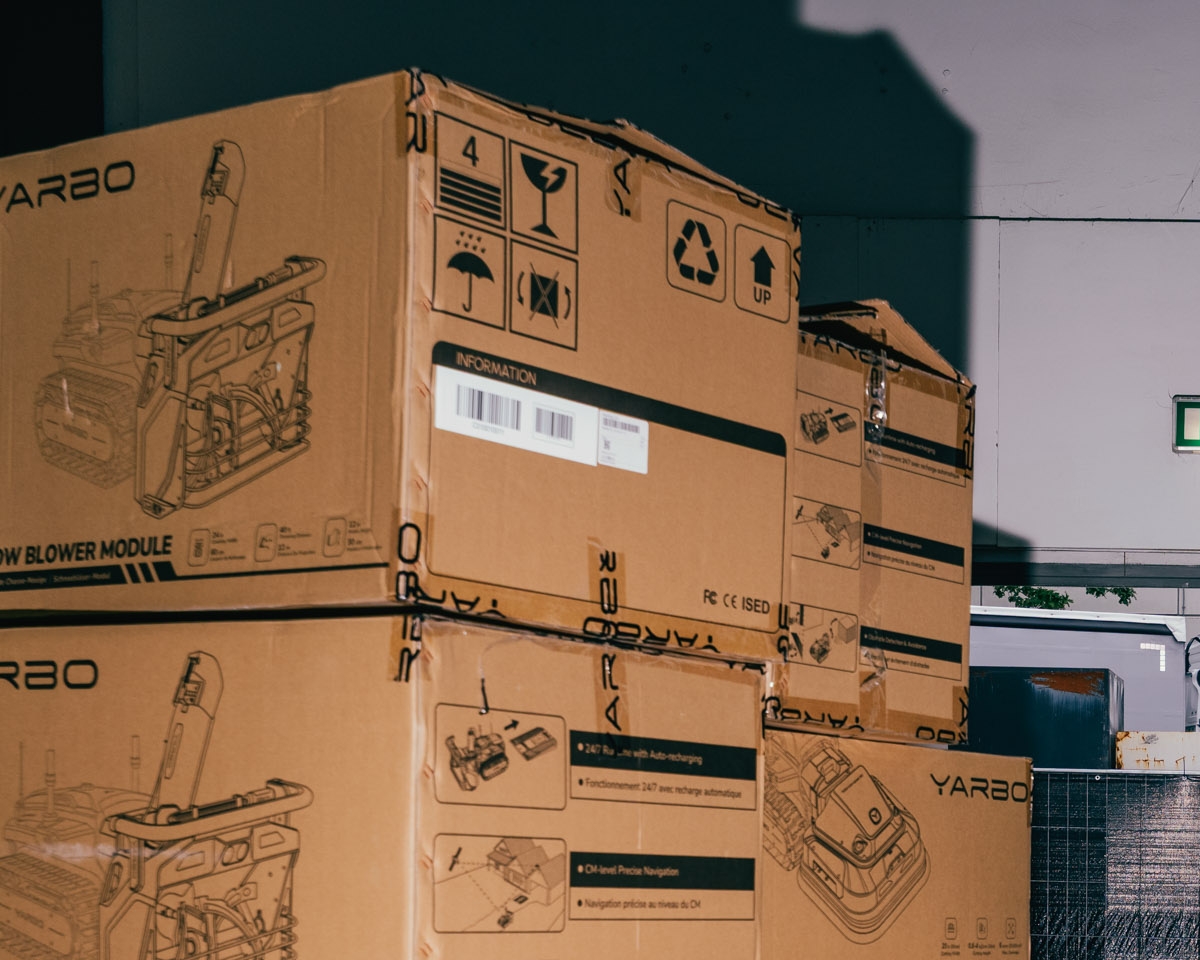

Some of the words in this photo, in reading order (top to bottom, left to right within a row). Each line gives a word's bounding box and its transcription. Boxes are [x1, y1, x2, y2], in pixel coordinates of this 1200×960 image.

[461, 135, 479, 168] 4
[753, 286, 773, 306] UP
[456, 351, 538, 387] INFORMATION
[25, 540, 96, 566] BLOWER
[100, 534, 174, 560] MODULE
[742, 596, 770, 614] ISED
[633, 748, 648, 759] with
[650, 749, 703, 766] Auto-recharging
[585, 777, 641, 791] Fonctionnement
[659, 784, 674, 794] avec
[675, 784, 702, 798] recharge
[704, 786, 742, 799] automatique
[930, 773, 1029, 804] YARBO
[618, 865, 642, 876] Precise
[644, 865, 680, 879] Navigation
[584, 898, 621, 911] Navigation
[623, 898, 648, 911] précise
[648, 900, 656, 909] au
[658, 899, 679, 909] niveau
[680, 898, 689, 909] du
